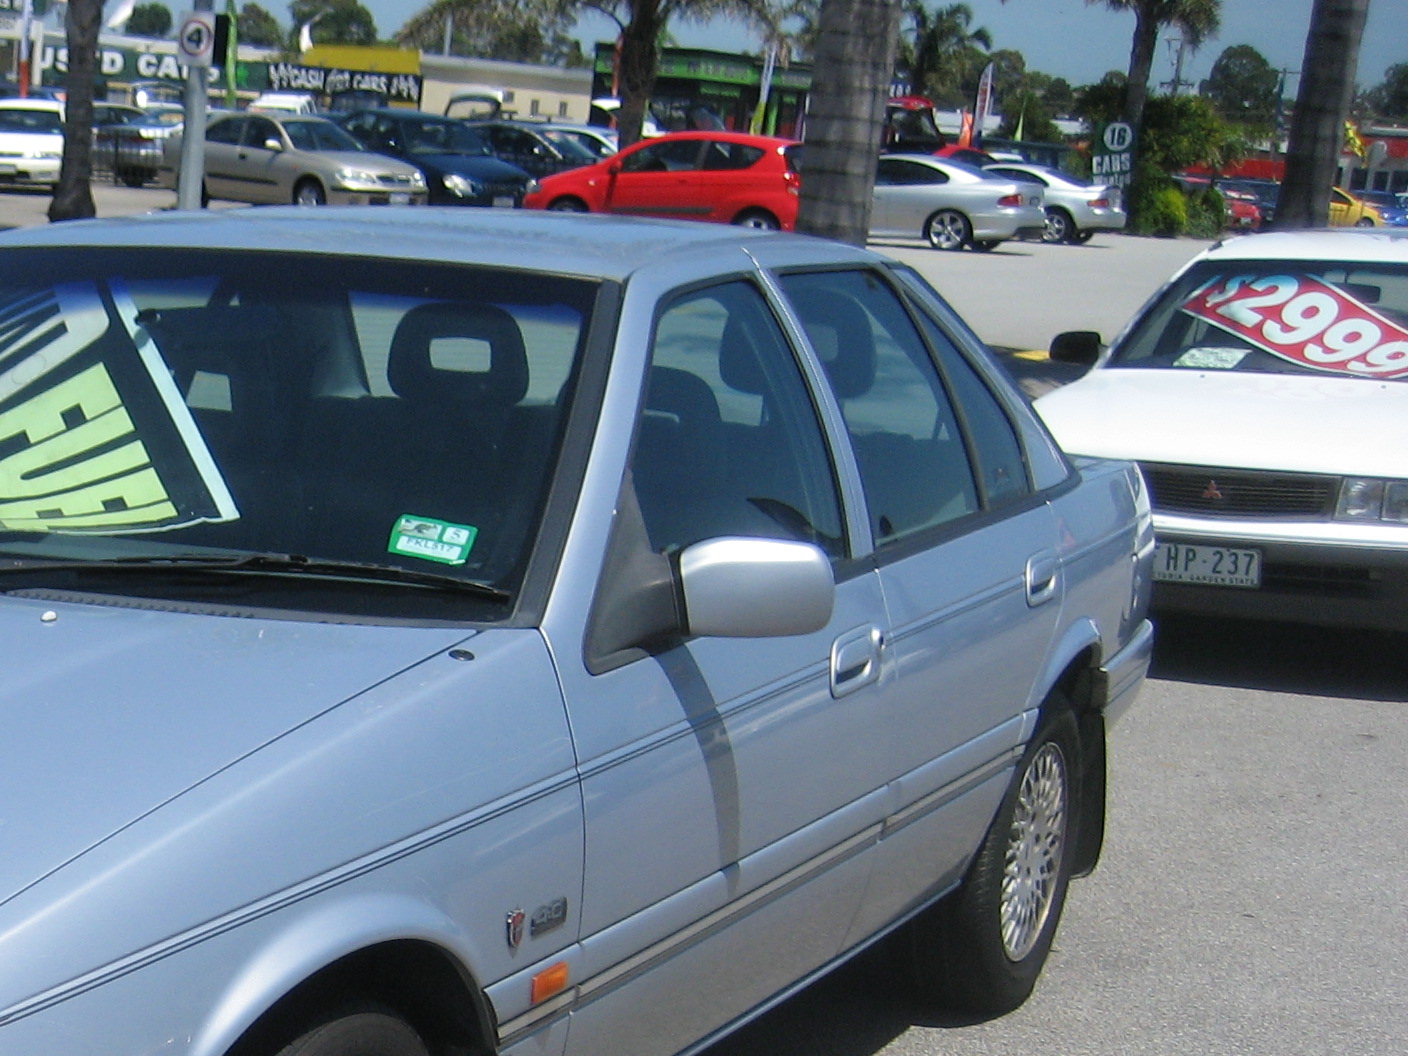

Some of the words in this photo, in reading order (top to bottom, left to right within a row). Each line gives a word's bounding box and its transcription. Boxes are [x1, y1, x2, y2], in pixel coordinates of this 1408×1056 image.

[187, 28, 203, 49] 4
[42, 47, 124, 75] USD
[137, 53, 220, 82] CAS
[1092, 153, 1131, 175] CARS
